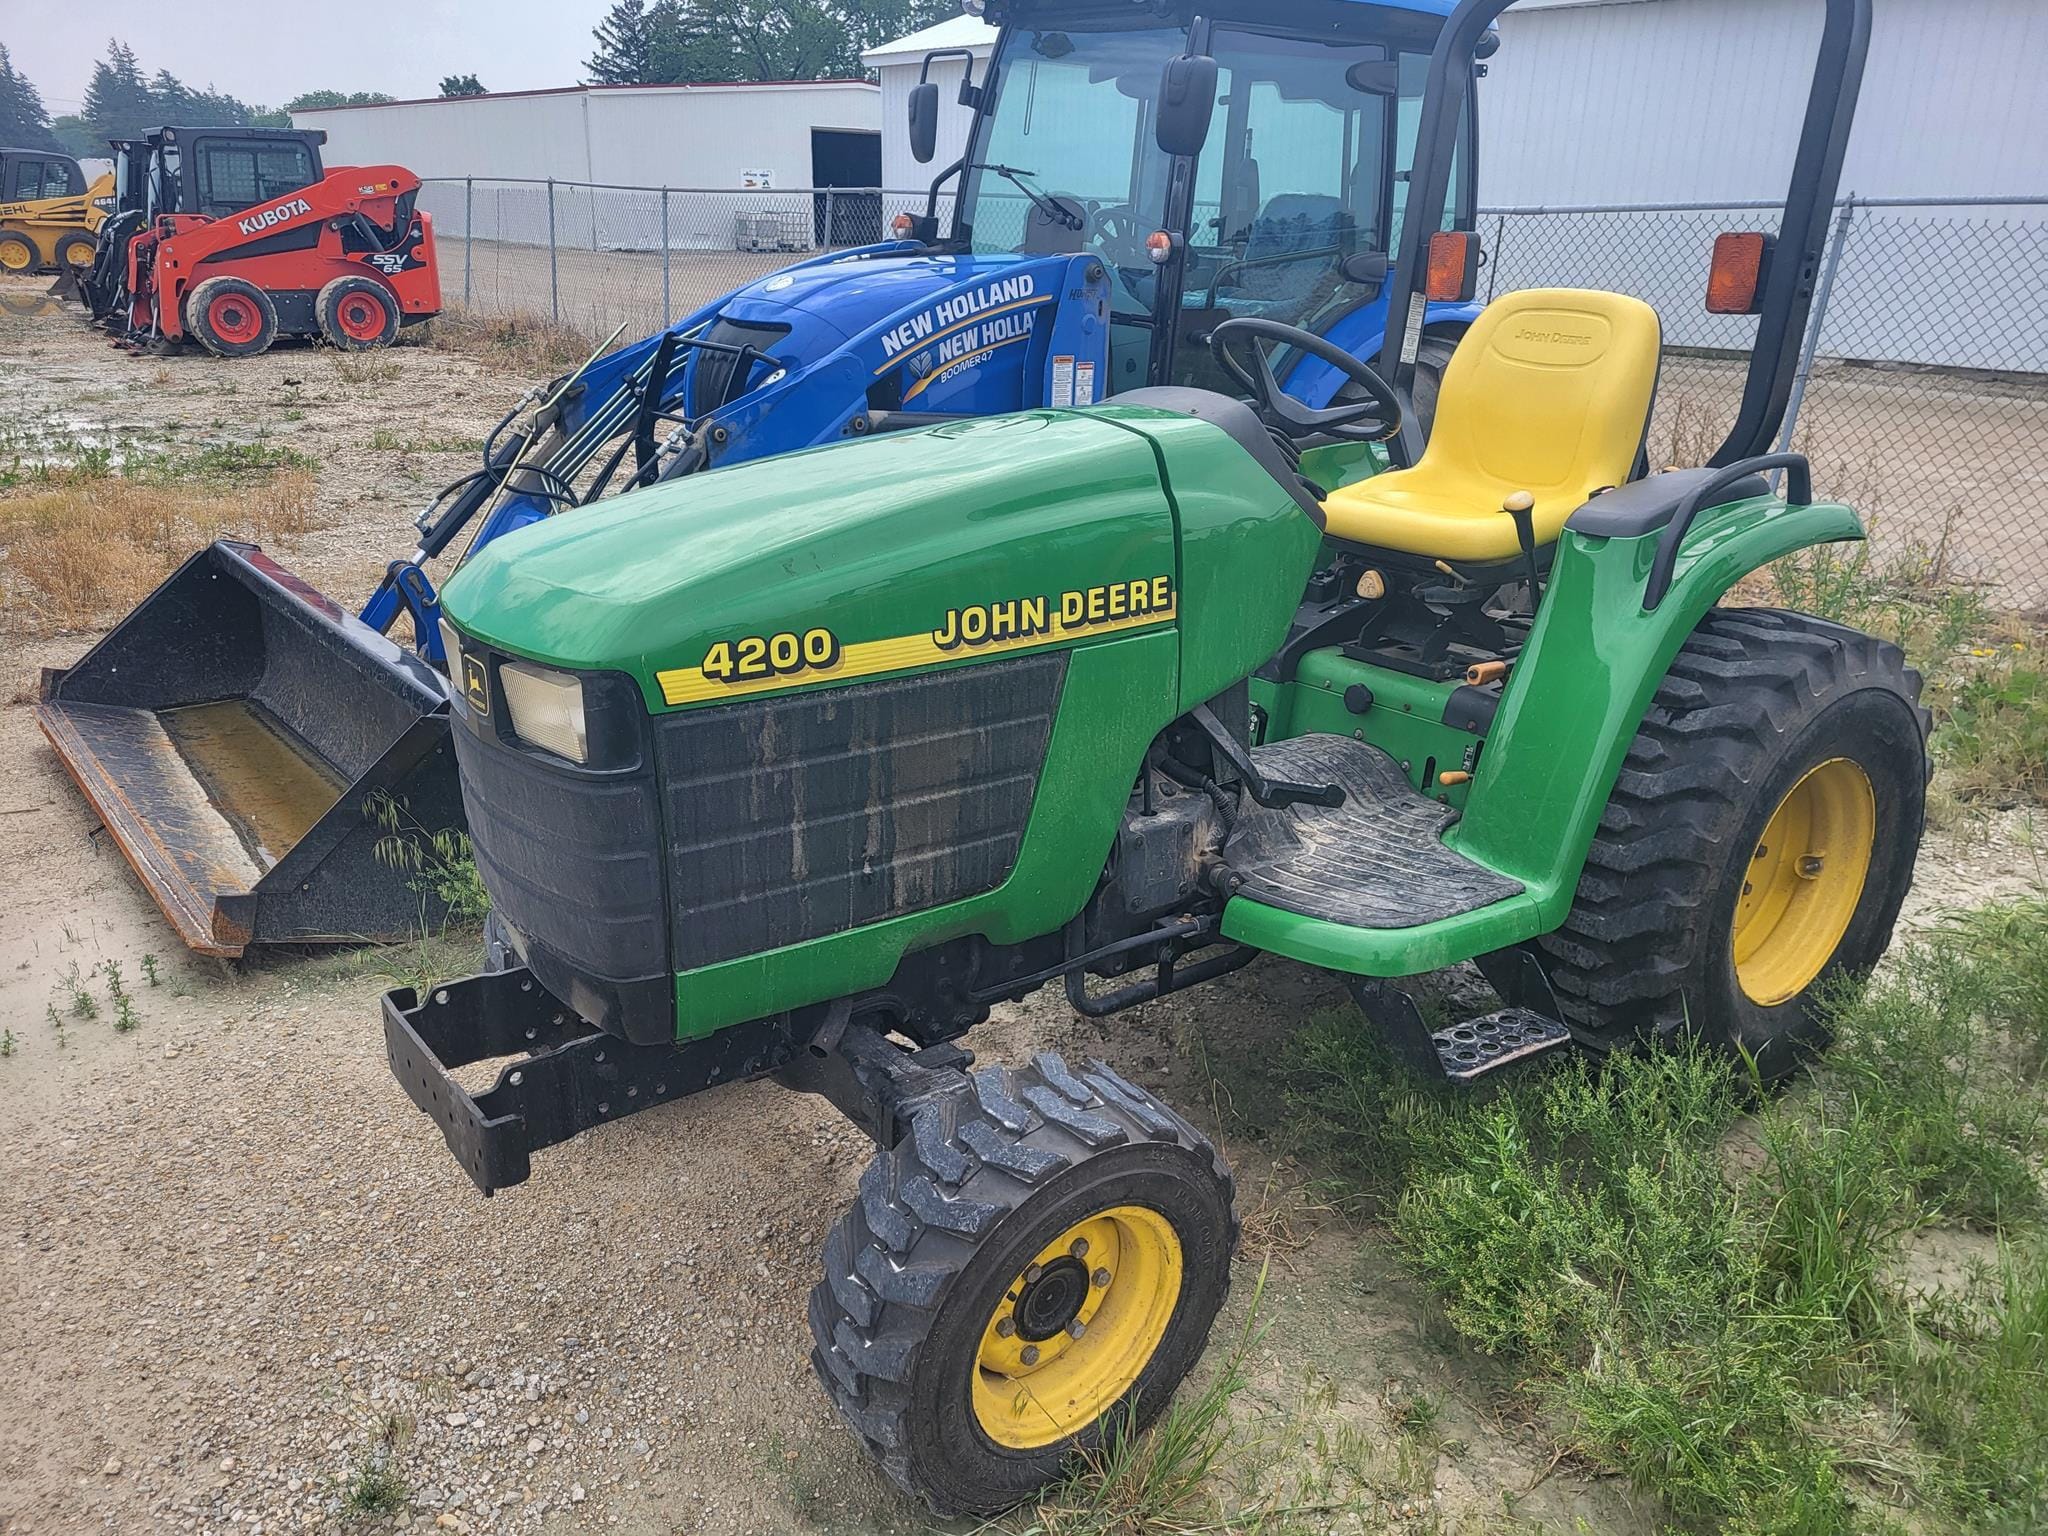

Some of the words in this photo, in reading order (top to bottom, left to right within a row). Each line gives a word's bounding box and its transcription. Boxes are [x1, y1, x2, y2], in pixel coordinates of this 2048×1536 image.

[237, 198, 312, 236] KUBOTA
[372, 254, 408, 265] SSV
[384, 265, 402, 273] 65
[881, 309, 933, 357] NEW
[935, 274, 1034, 327] HOLLAND
[939, 326, 979, 364] NEW
[702, 628, 838, 681] 4200
[933, 596, 1050, 650] JOHN
[1061, 576, 1172, 627] DEERE
